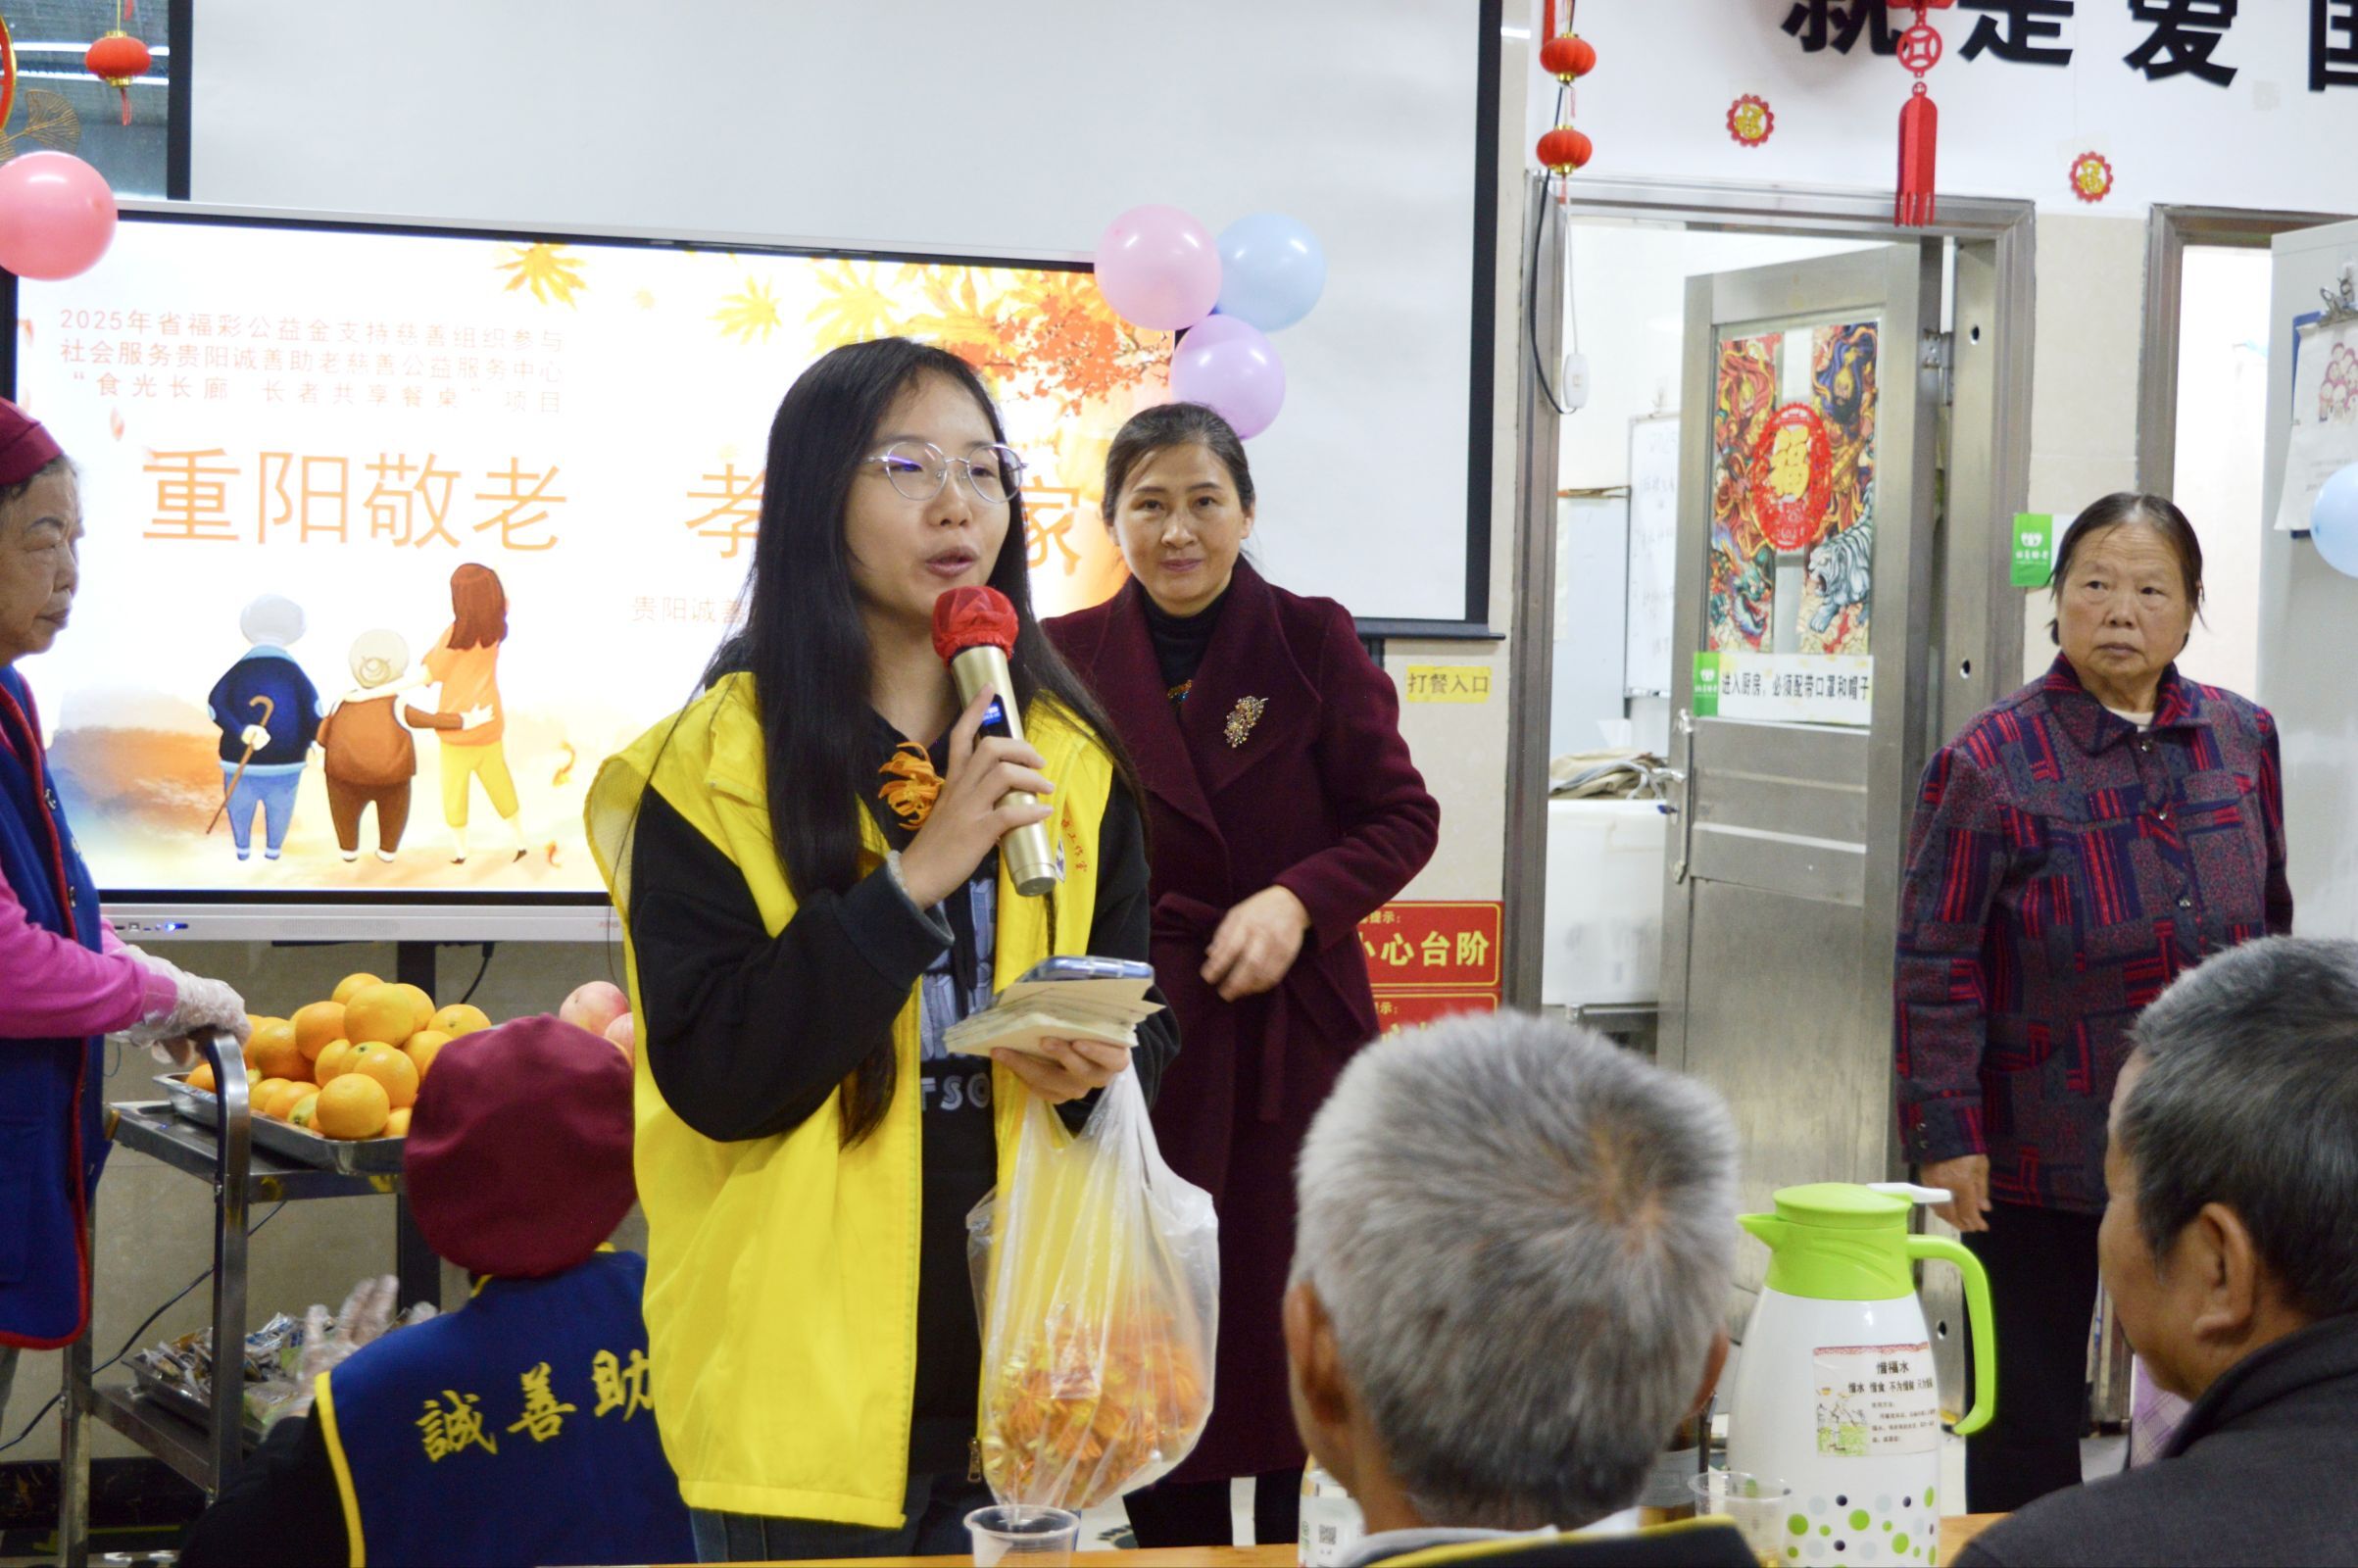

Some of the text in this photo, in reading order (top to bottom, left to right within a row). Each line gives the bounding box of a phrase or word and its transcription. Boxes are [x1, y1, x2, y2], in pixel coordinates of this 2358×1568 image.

[60, 308, 565, 353] 2025年省福彩公益金支持慈善组织参与
[142, 447, 567, 552] 重阳敬老
[1407, 673, 1490, 695] 打餐入口
[415, 1348, 654, 1463] 誠善助
